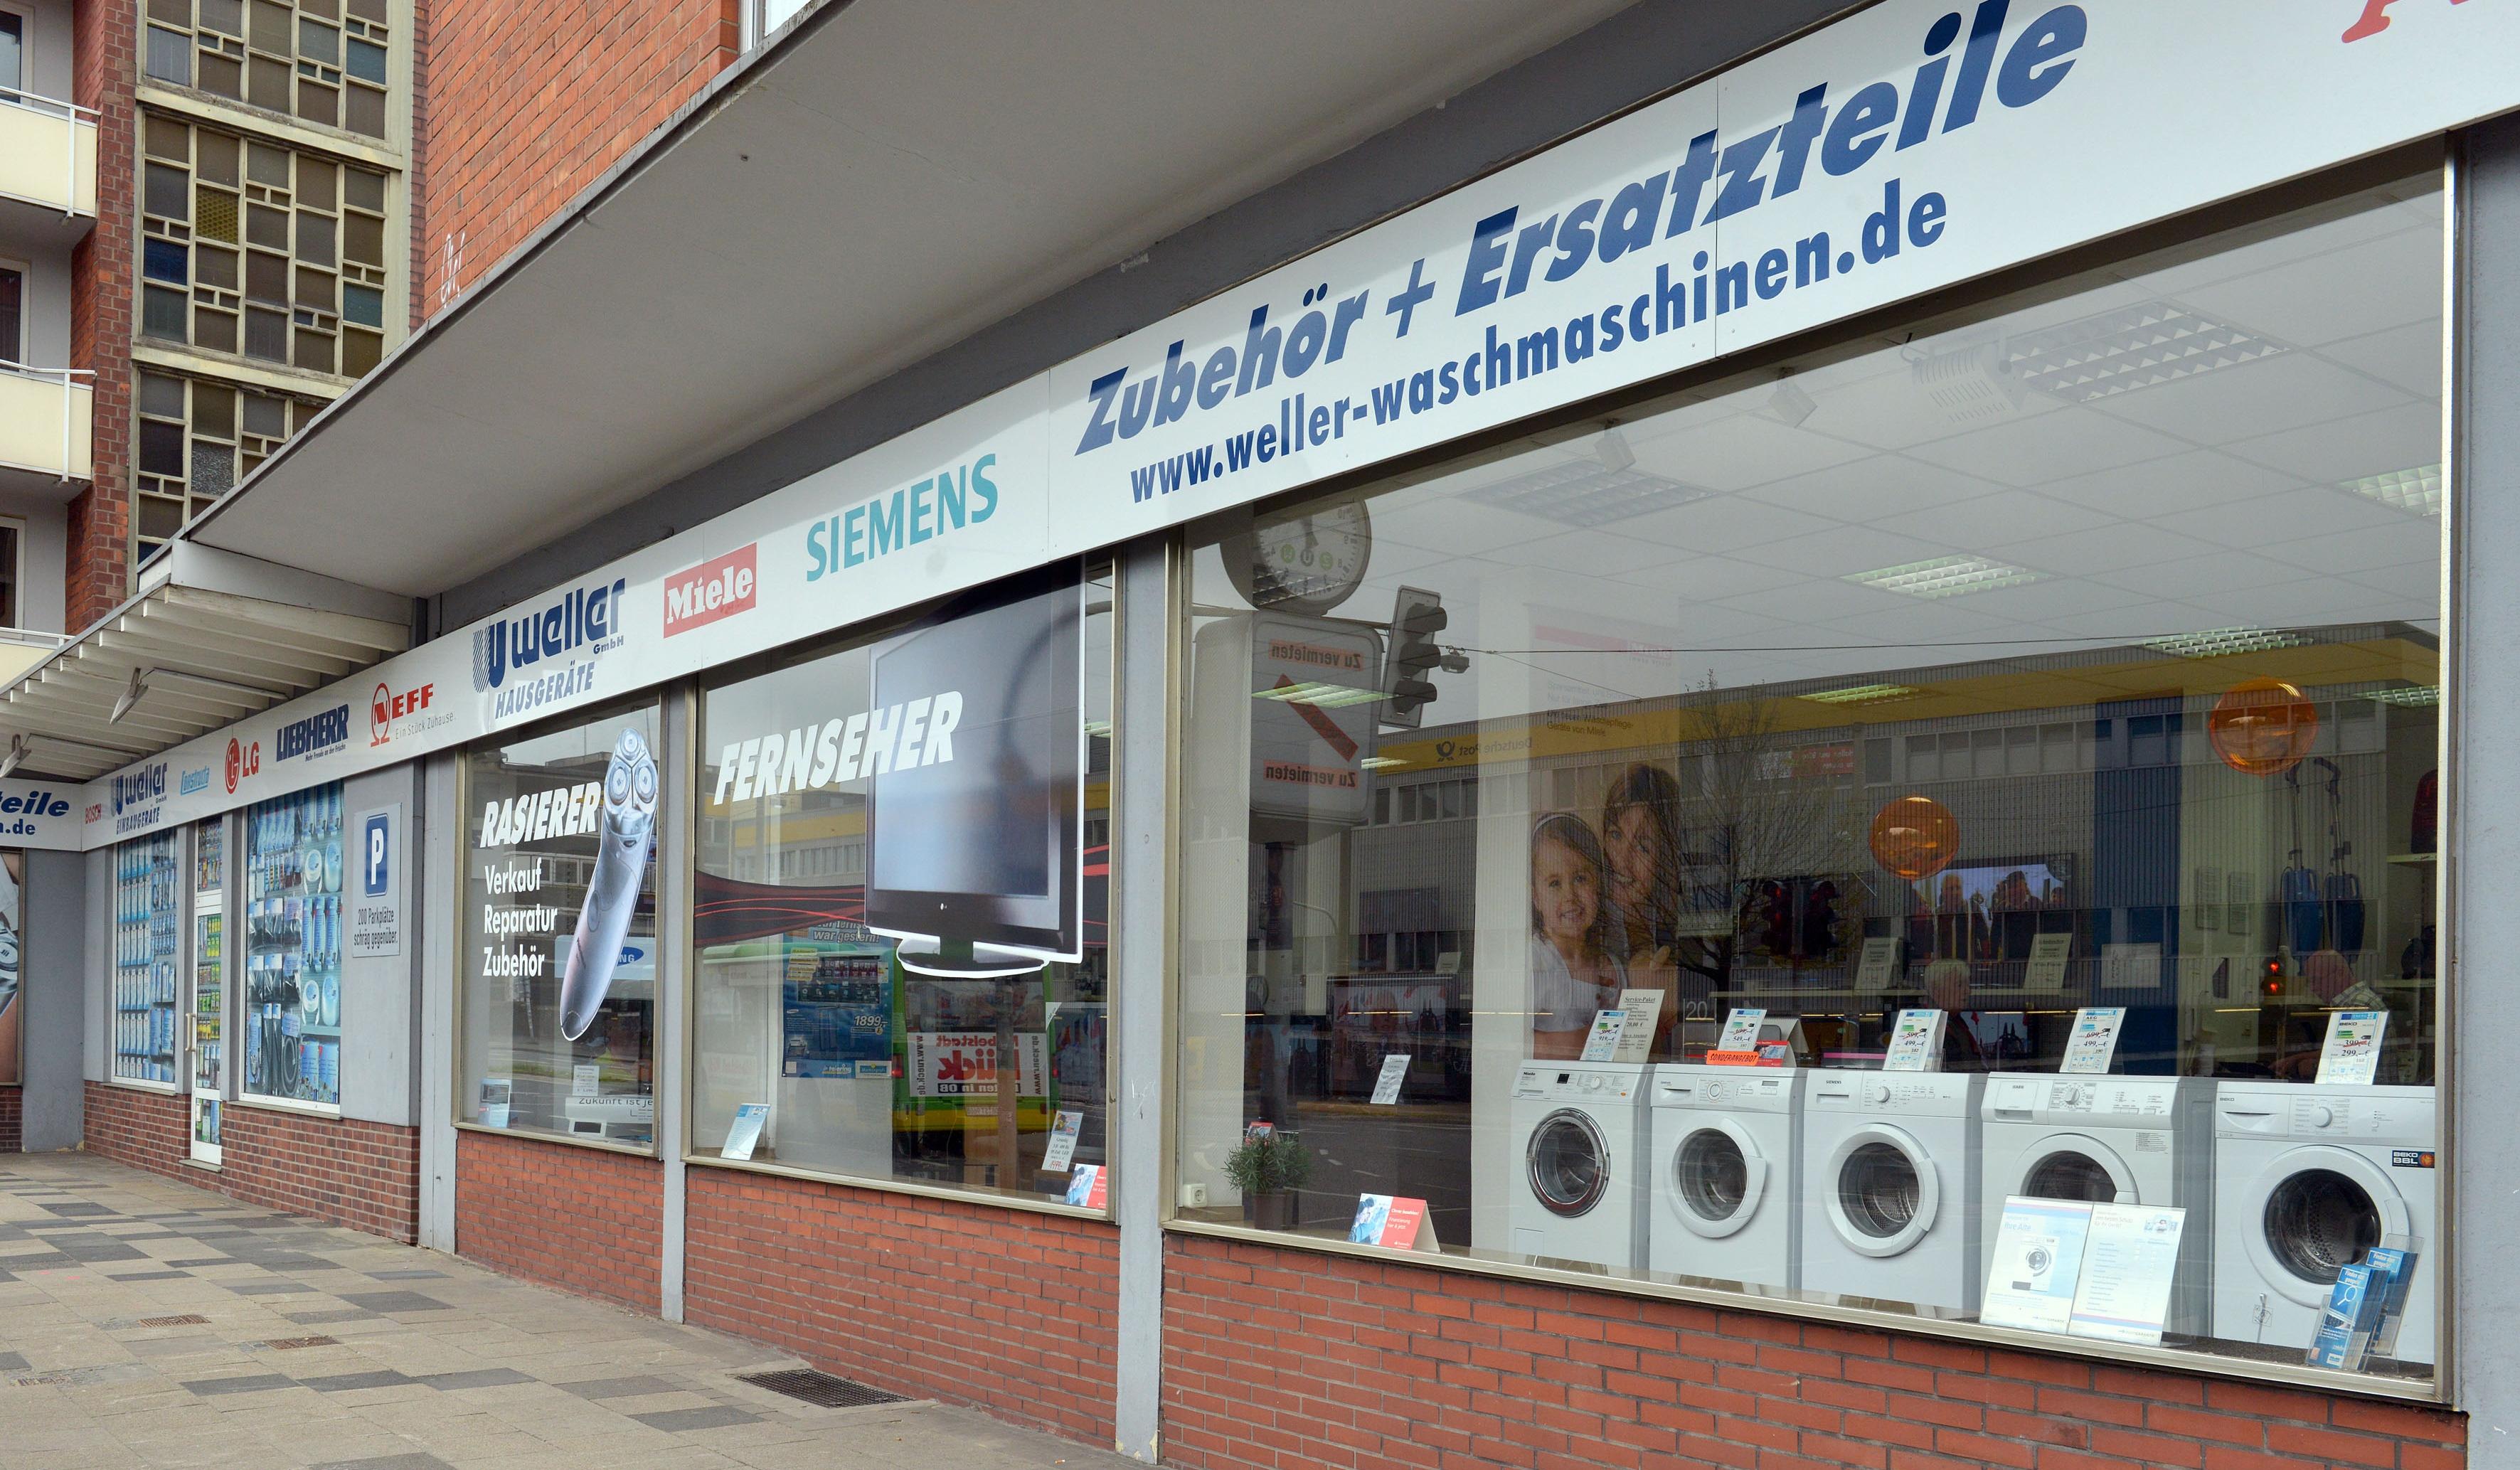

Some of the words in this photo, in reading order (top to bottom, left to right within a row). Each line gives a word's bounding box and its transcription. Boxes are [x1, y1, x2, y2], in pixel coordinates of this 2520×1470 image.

[1075, 283, 1370, 455] Zubehör
[1455, 0, 2088, 317] Ersatzteile
[1130, 179, 1947, 504] www.weller-waschmaschinen.de
[807, 453, 998, 582] SIEMENS
[667, 566, 753, 624] Miele
[511, 578, 625, 669] weller
[593, 636, 624, 655] GmbH
[373, 683, 434, 725] NEFF
[495, 660, 595, 720] HAUSGERÄTE
[276, 704, 349, 762] LIEBHERR
[395, 728, 405, 740] Ein
[407, 721, 425, 737] Stück
[713, 691, 963, 806] FERNSEHER
[243, 741, 260, 777] LG
[125, 762, 167, 805] weller
[155, 795, 167, 804] GmbH
[0, 791, 70, 817] eile
[85, 803, 102, 825] BOSCH
[116, 804, 160, 835] EINBAUGERÄTE
[479, 782, 602, 848] RASIERER
[0, 819, 36, 835] .de
[371, 828, 384, 885] P
[484, 858, 542, 894] Verkauf
[358, 907, 367, 925] 200
[368, 905, 394, 928] Parkplätze
[484, 903, 558, 941] Reparatur
[354, 928, 371, 949] schräg
[371, 927, 398, 949] gegenüber.
[814, 931, 836, 940] war
[837, 931, 880, 943] gestern!
[483, 944, 545, 976] Zubehör
[1686, 1001, 1708, 1019] 20
[1709, 1053, 1758, 1062] SONDERANGEBOT
[2393, 1156, 2419, 1165] BBL
